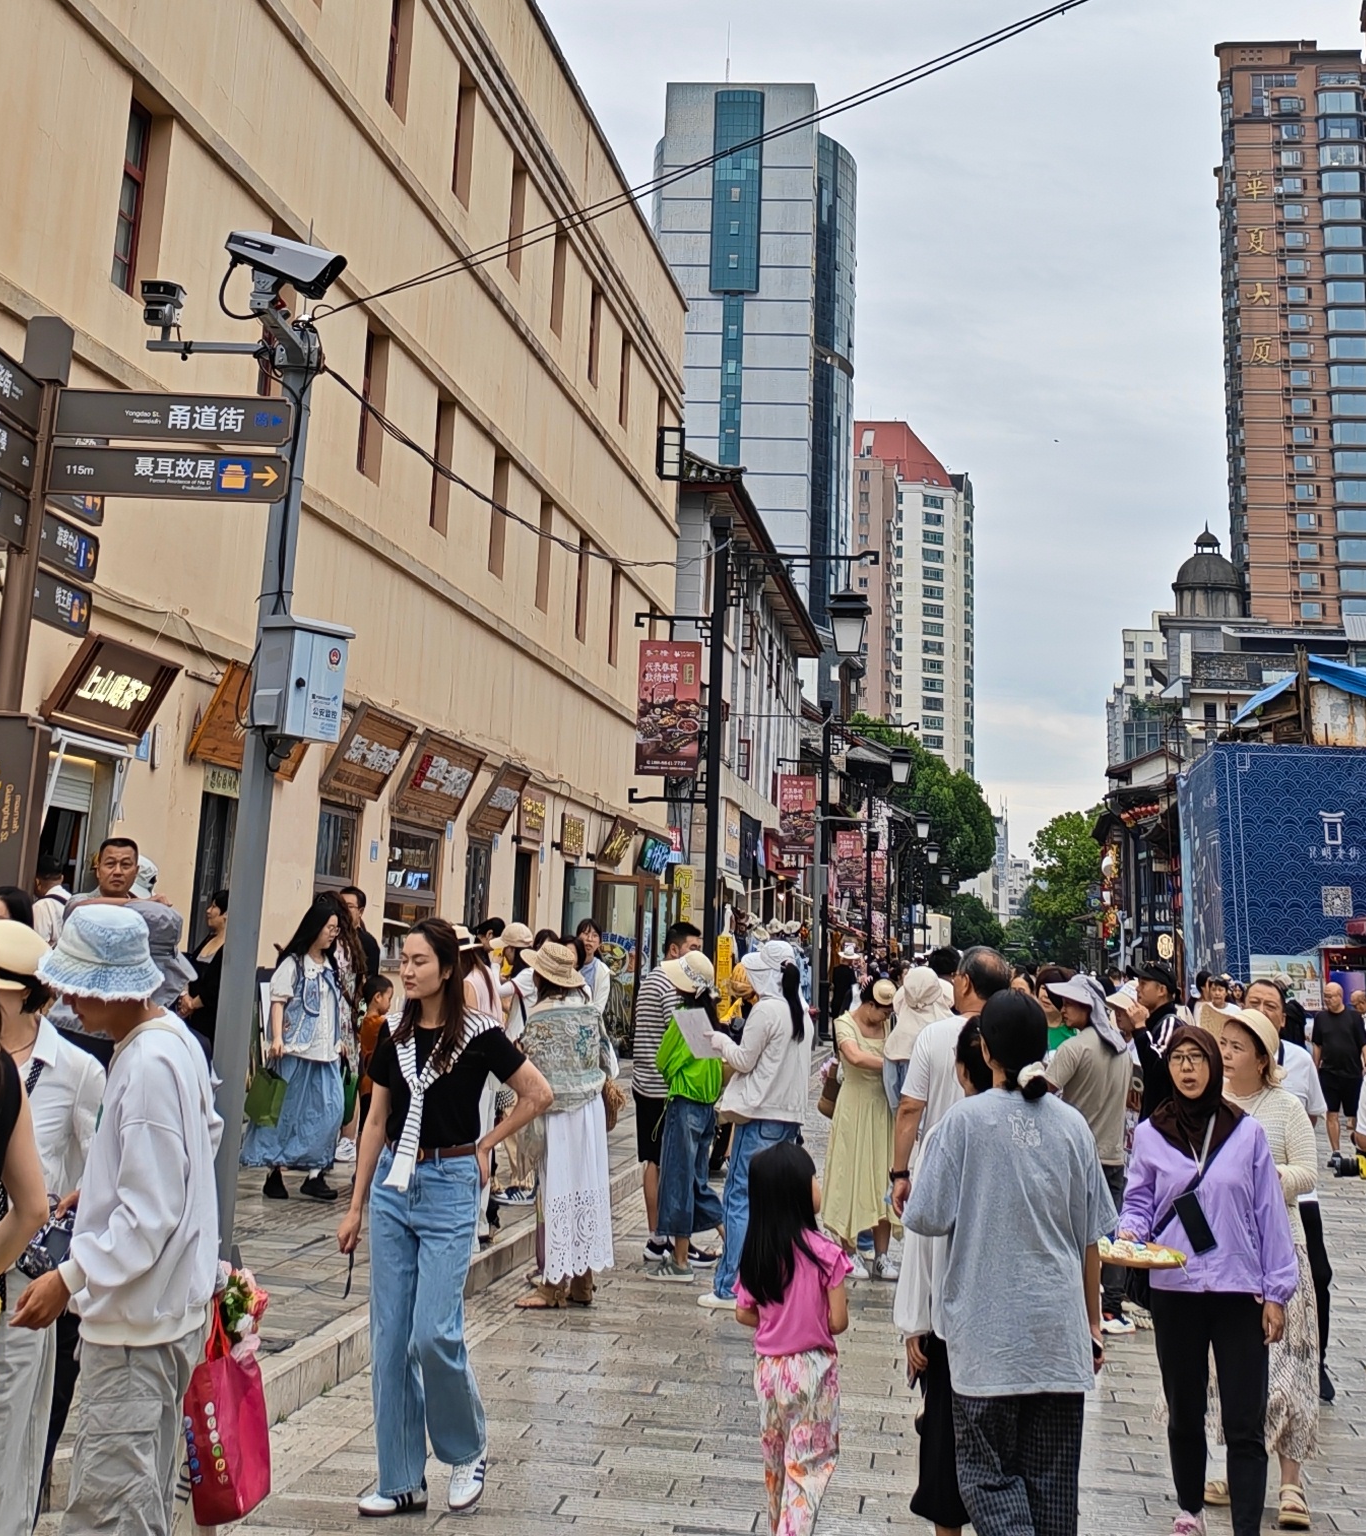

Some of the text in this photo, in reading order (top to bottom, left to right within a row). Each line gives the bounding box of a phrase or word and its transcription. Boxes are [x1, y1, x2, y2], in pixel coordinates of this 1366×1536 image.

[124, 409, 151, 418] Yongdao
[167, 404, 245, 433] 甬道街
[66, 464, 94, 476] 115m
[134, 457, 215, 479] 聂耳故居
[56, 526, 80, 554] 游客中心
[1, 783, 14, 830] Guanghua
